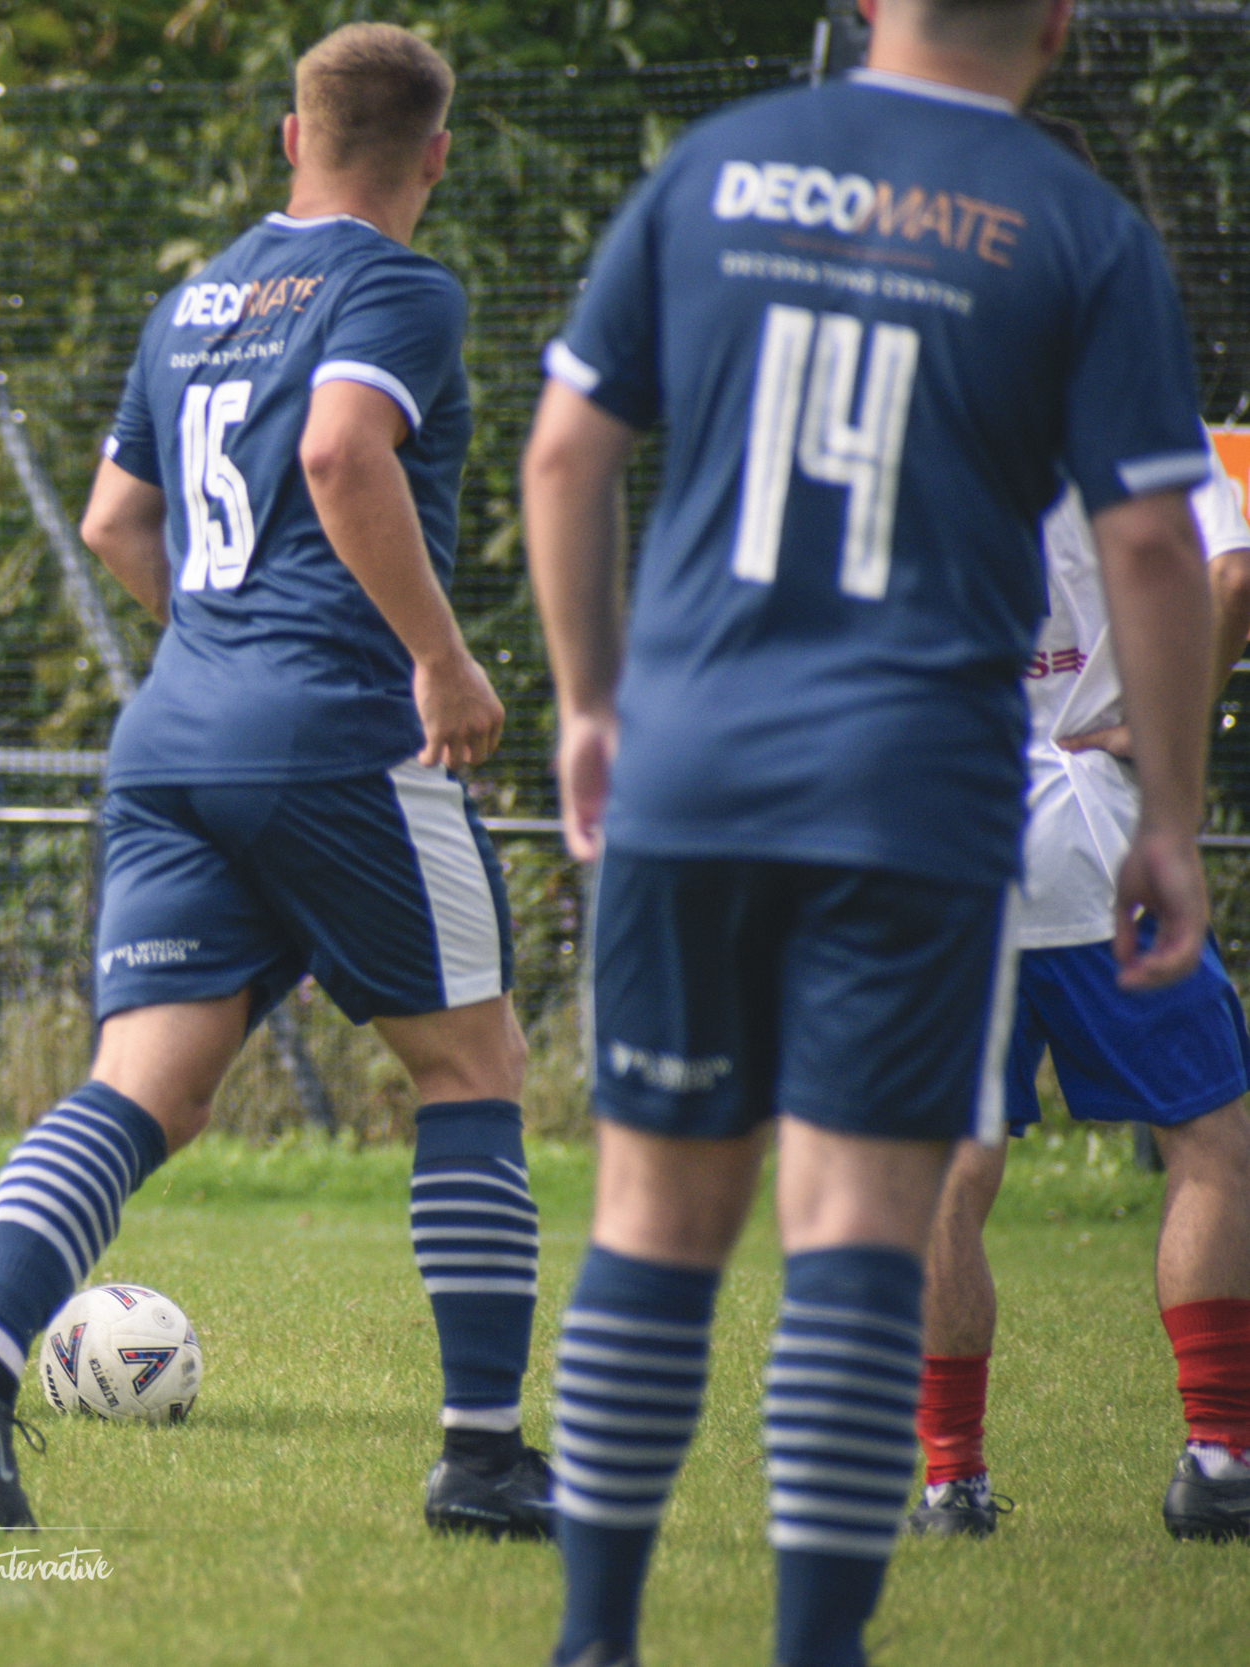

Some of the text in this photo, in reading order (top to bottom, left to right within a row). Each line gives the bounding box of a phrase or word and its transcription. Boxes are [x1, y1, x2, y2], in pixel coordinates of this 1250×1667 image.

[713, 159, 1026, 269] DECOMATE
[180, 380, 254, 591] 15
[731, 303, 920, 601] 14
[127, 950, 187, 968] SYSTEMS
[136, 938, 202, 953] WINDOW
